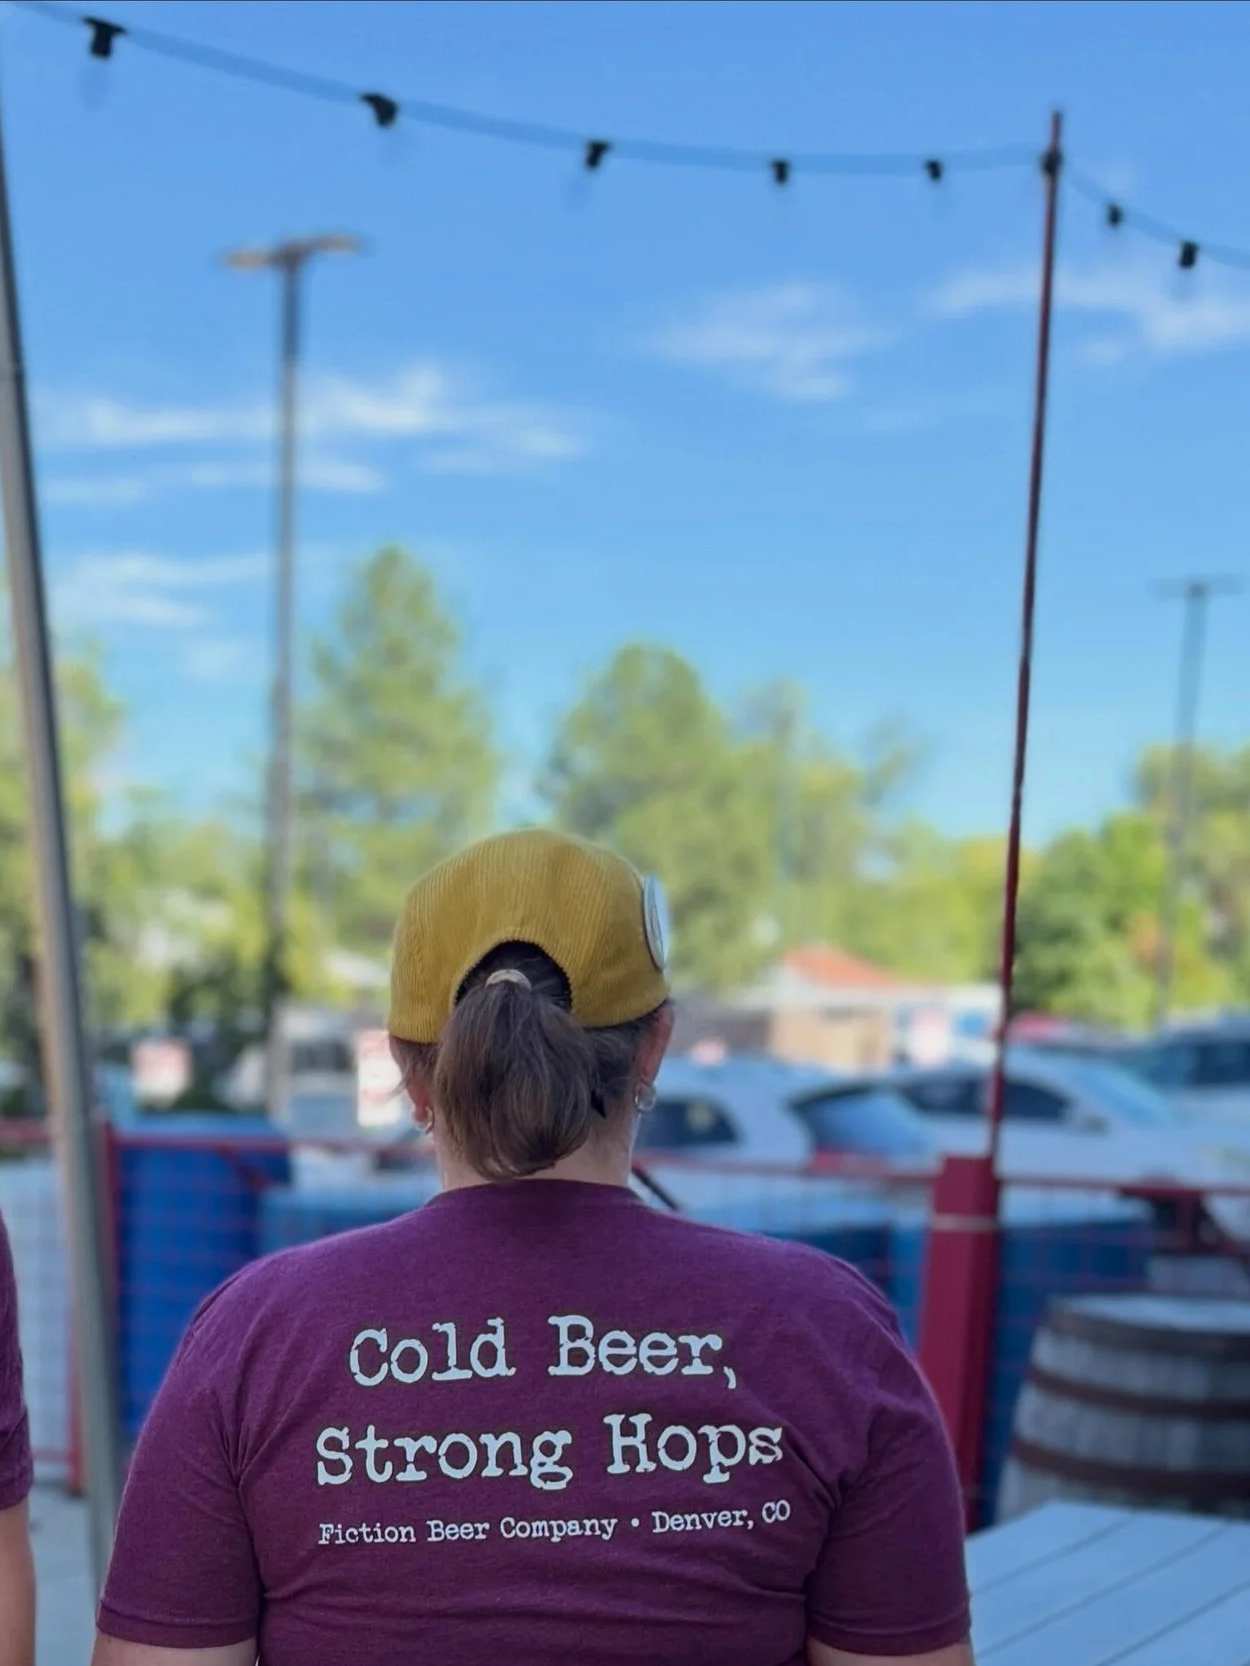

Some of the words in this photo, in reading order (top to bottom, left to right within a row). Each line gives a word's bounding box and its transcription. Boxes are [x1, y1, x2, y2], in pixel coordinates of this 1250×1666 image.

[349, 1317, 517, 1386] Cold
[547, 1314, 737, 1389] Beer,
[316, 1424, 574, 1491] Strong
[603, 1413, 784, 1485] Hops
[318, 1522, 417, 1545] Fiction
[426, 1519, 490, 1542] Beer
[499, 1516, 618, 1543] Company
[651, 1509, 754, 1533] Denver,
[761, 1499, 791, 1524] CO
